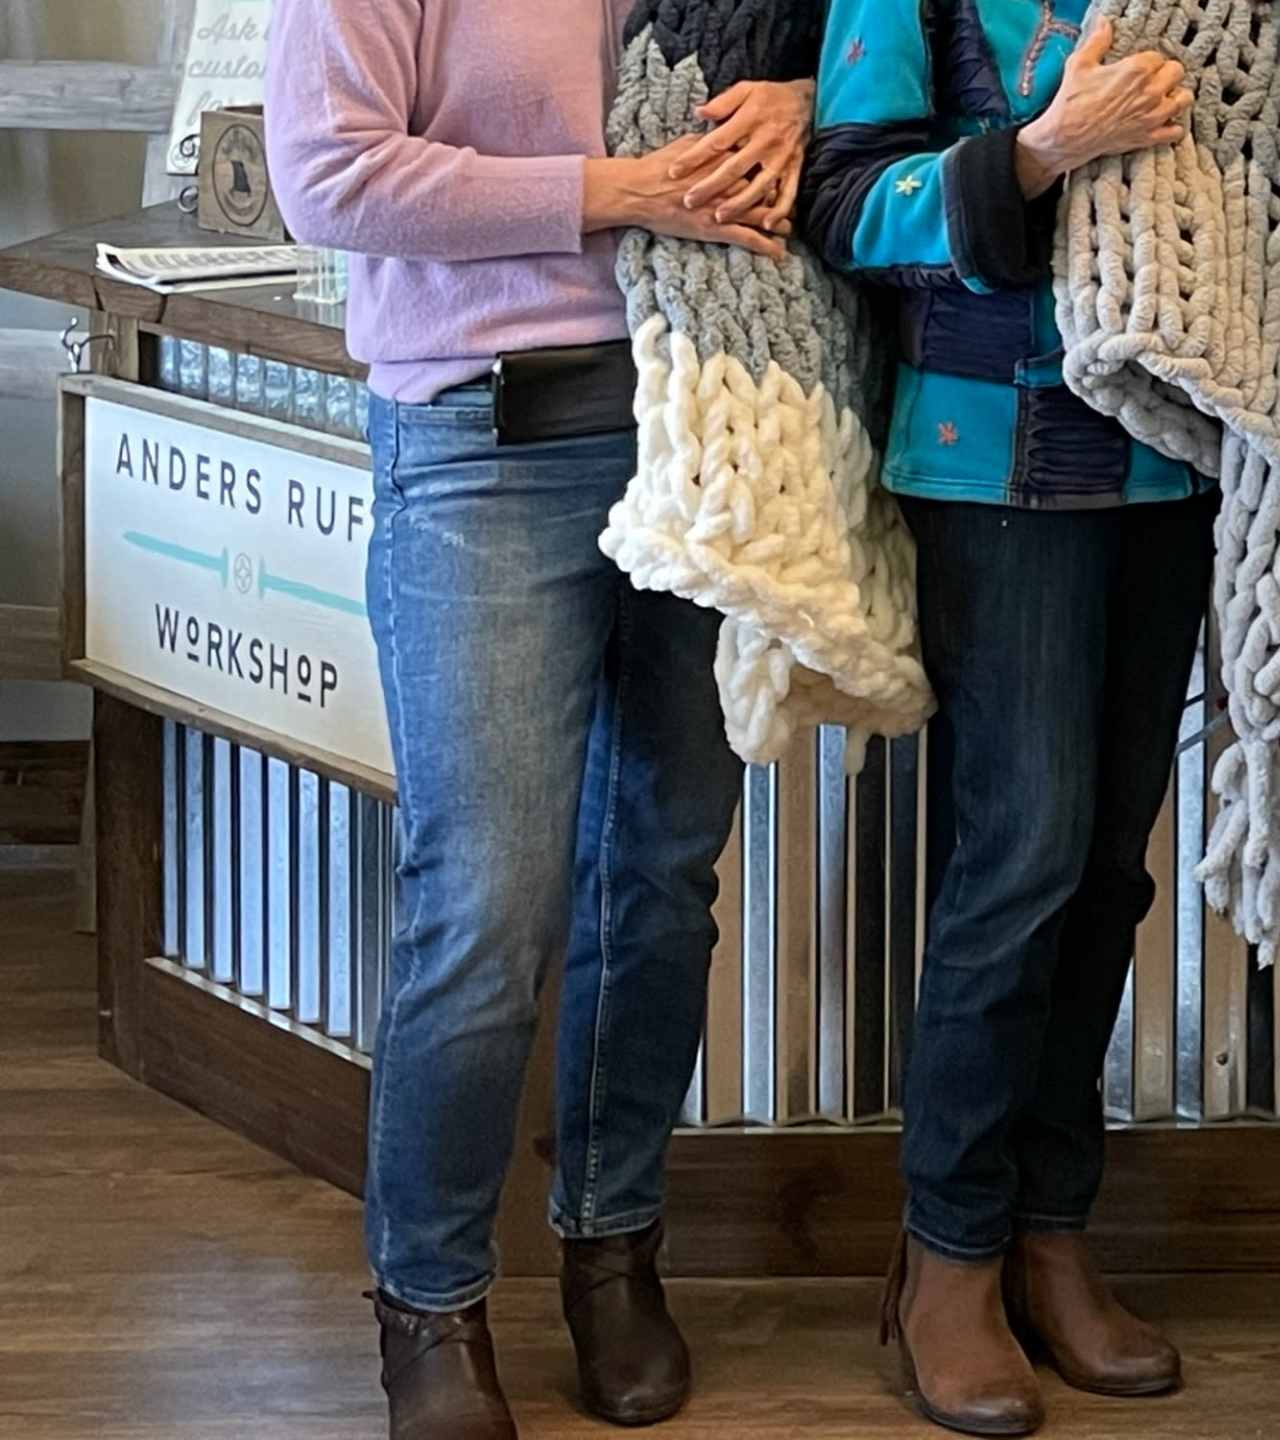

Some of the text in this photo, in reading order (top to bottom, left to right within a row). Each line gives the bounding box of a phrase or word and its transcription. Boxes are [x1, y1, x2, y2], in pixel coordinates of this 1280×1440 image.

[197, 12, 260, 42] Ask
[187, 58, 266, 81] custo
[115, 432, 366, 543] ANDERS RUF
[154, 602, 338, 708] WORKSHOP
